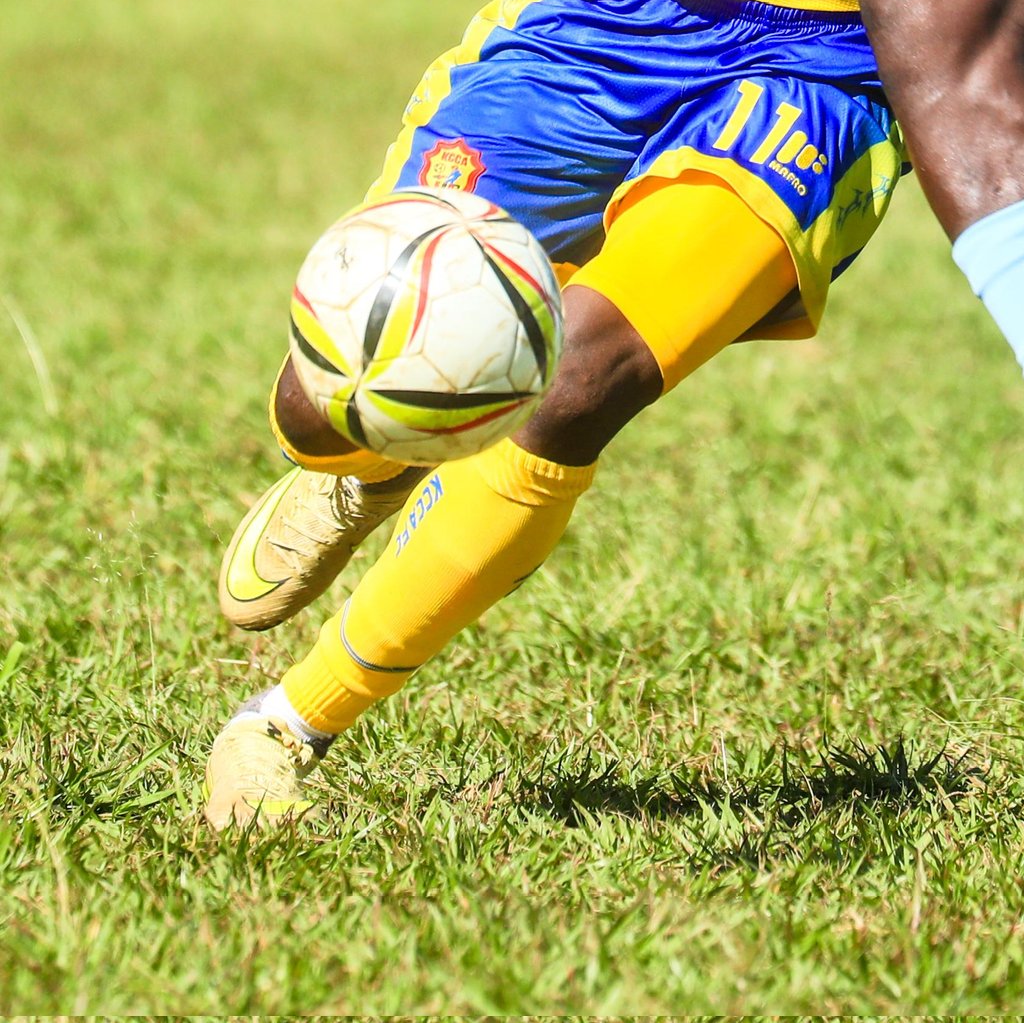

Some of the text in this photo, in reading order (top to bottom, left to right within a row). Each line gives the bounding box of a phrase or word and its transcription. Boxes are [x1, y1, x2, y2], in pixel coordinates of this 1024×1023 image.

[712, 79, 802, 164] 11
[441, 152, 468, 166] KCCA
[768, 159, 808, 196] MAFRO
